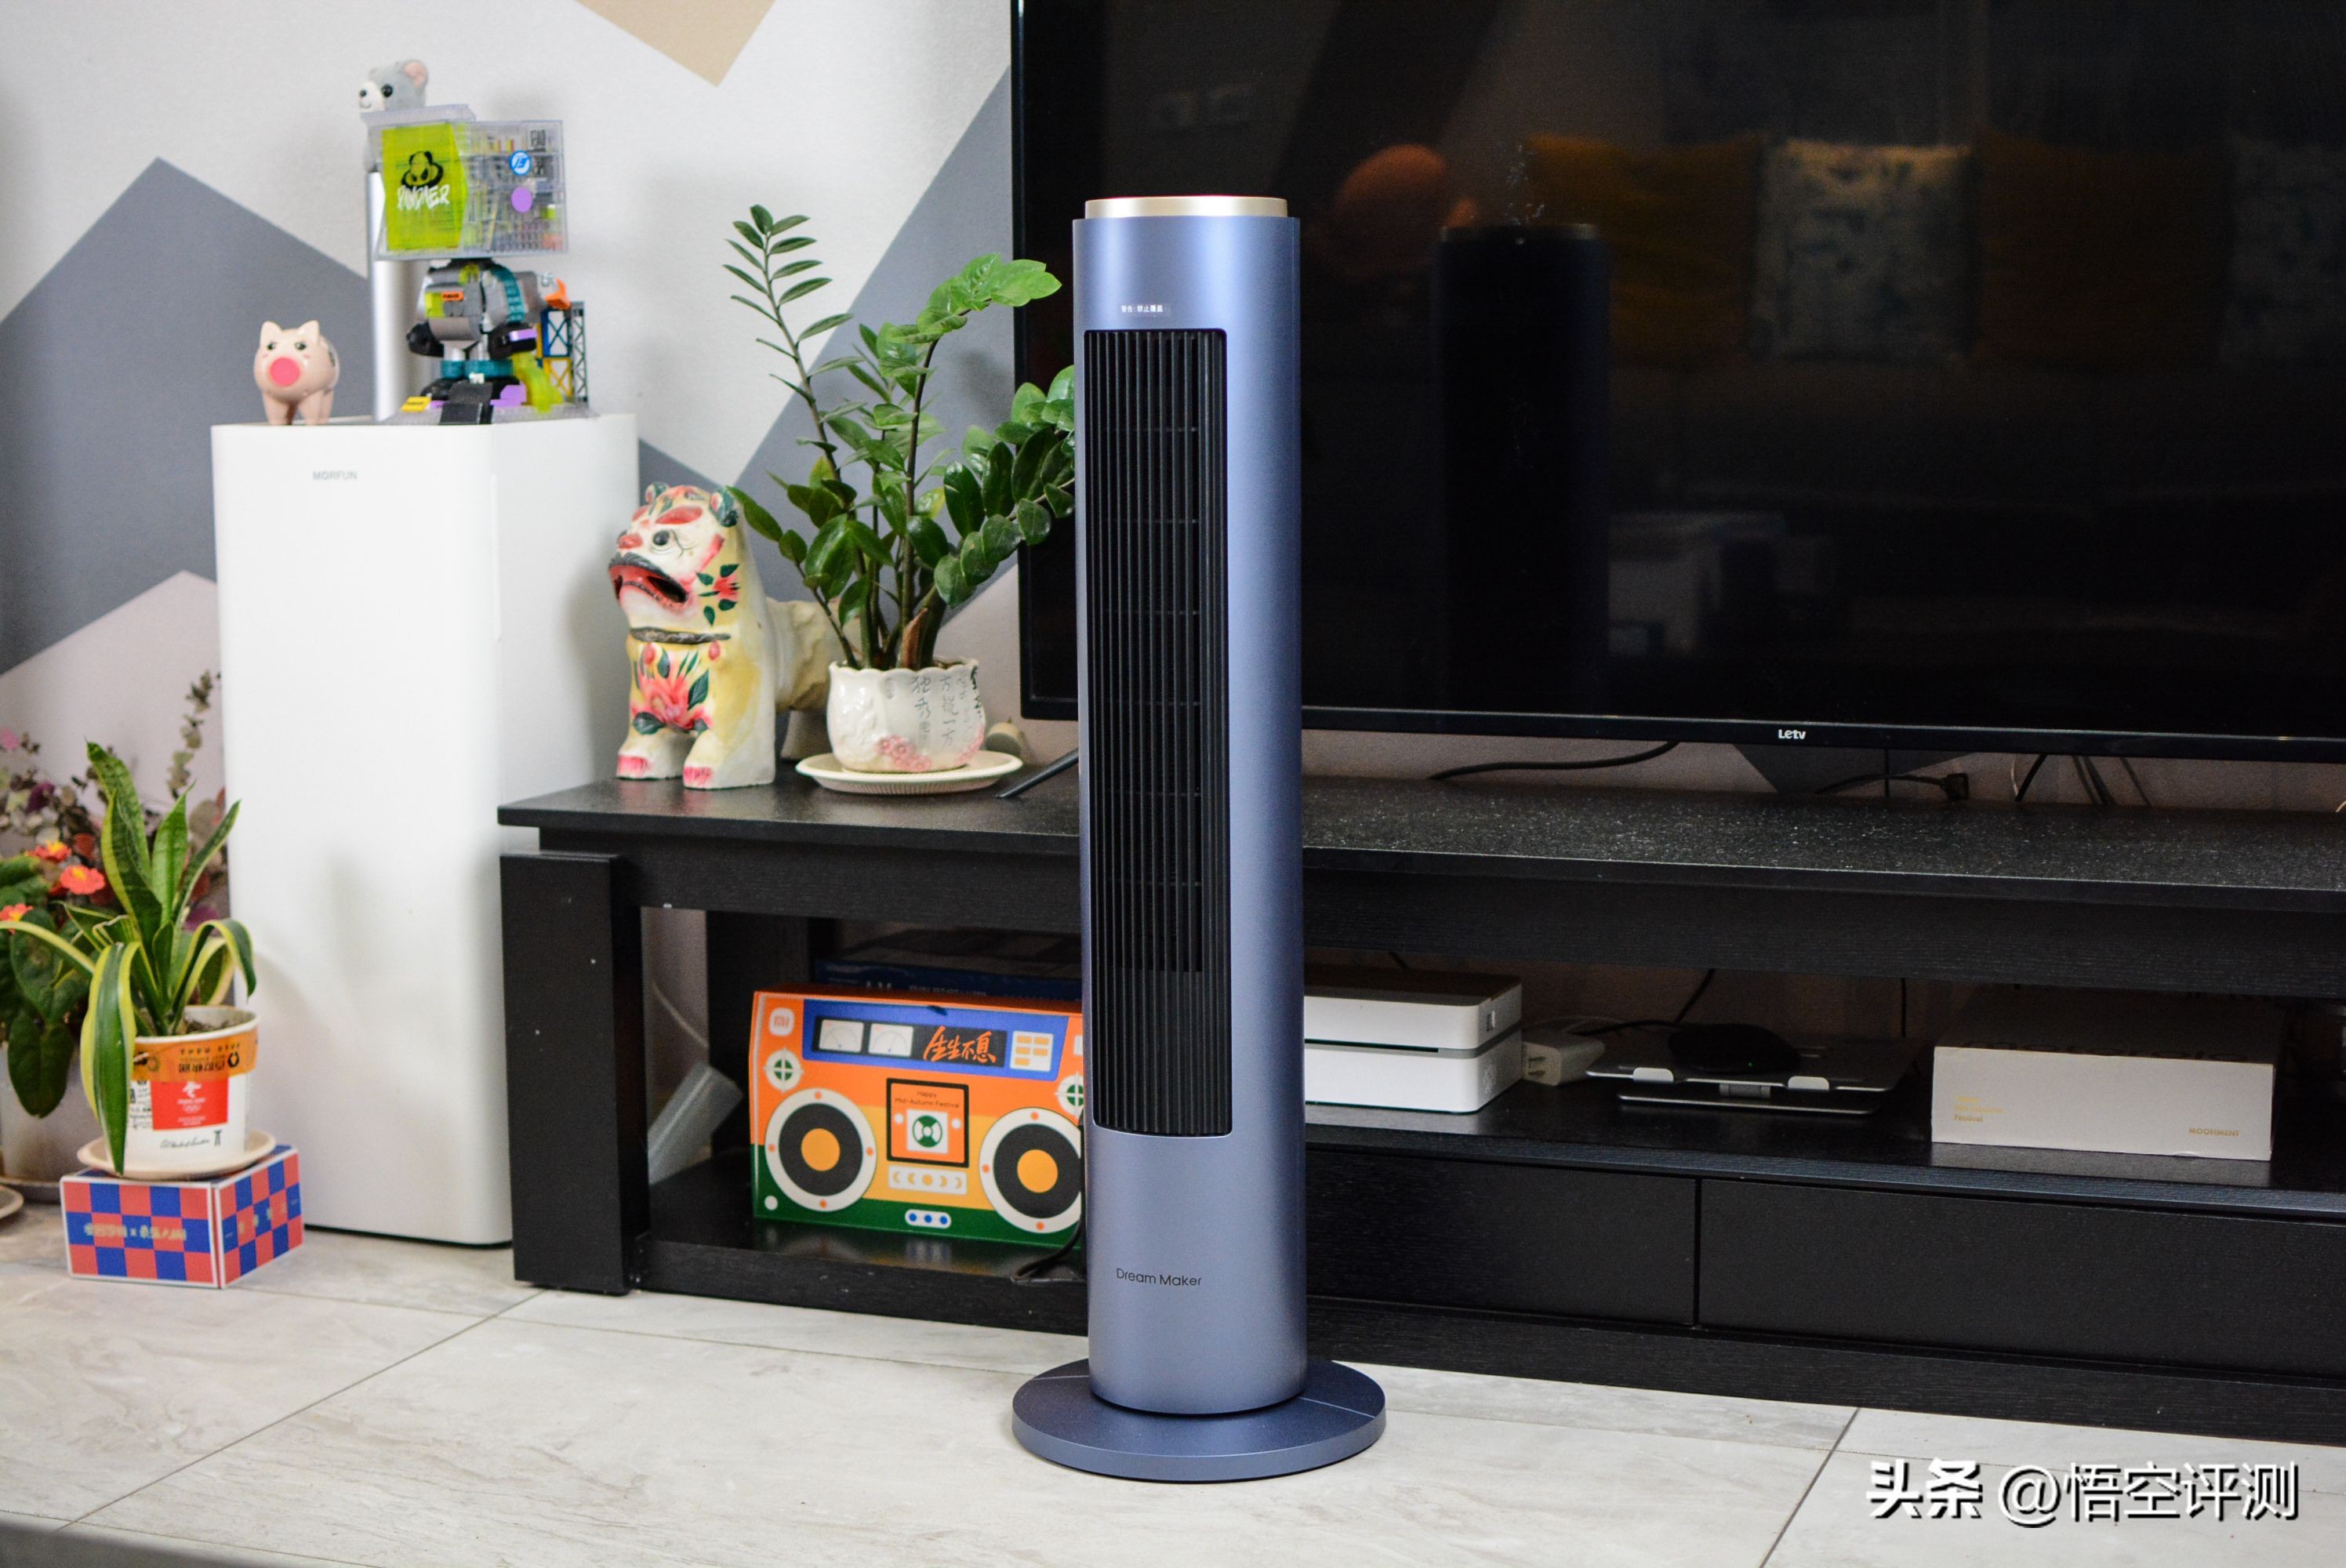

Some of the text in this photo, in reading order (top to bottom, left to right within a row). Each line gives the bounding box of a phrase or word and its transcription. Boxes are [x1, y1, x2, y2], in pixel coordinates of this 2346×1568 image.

[1778, 729, 1807, 739] Letv
[924, 1025, 996, 1063] 生生不息
[1116, 1268, 1202, 1287] Dream Maker
